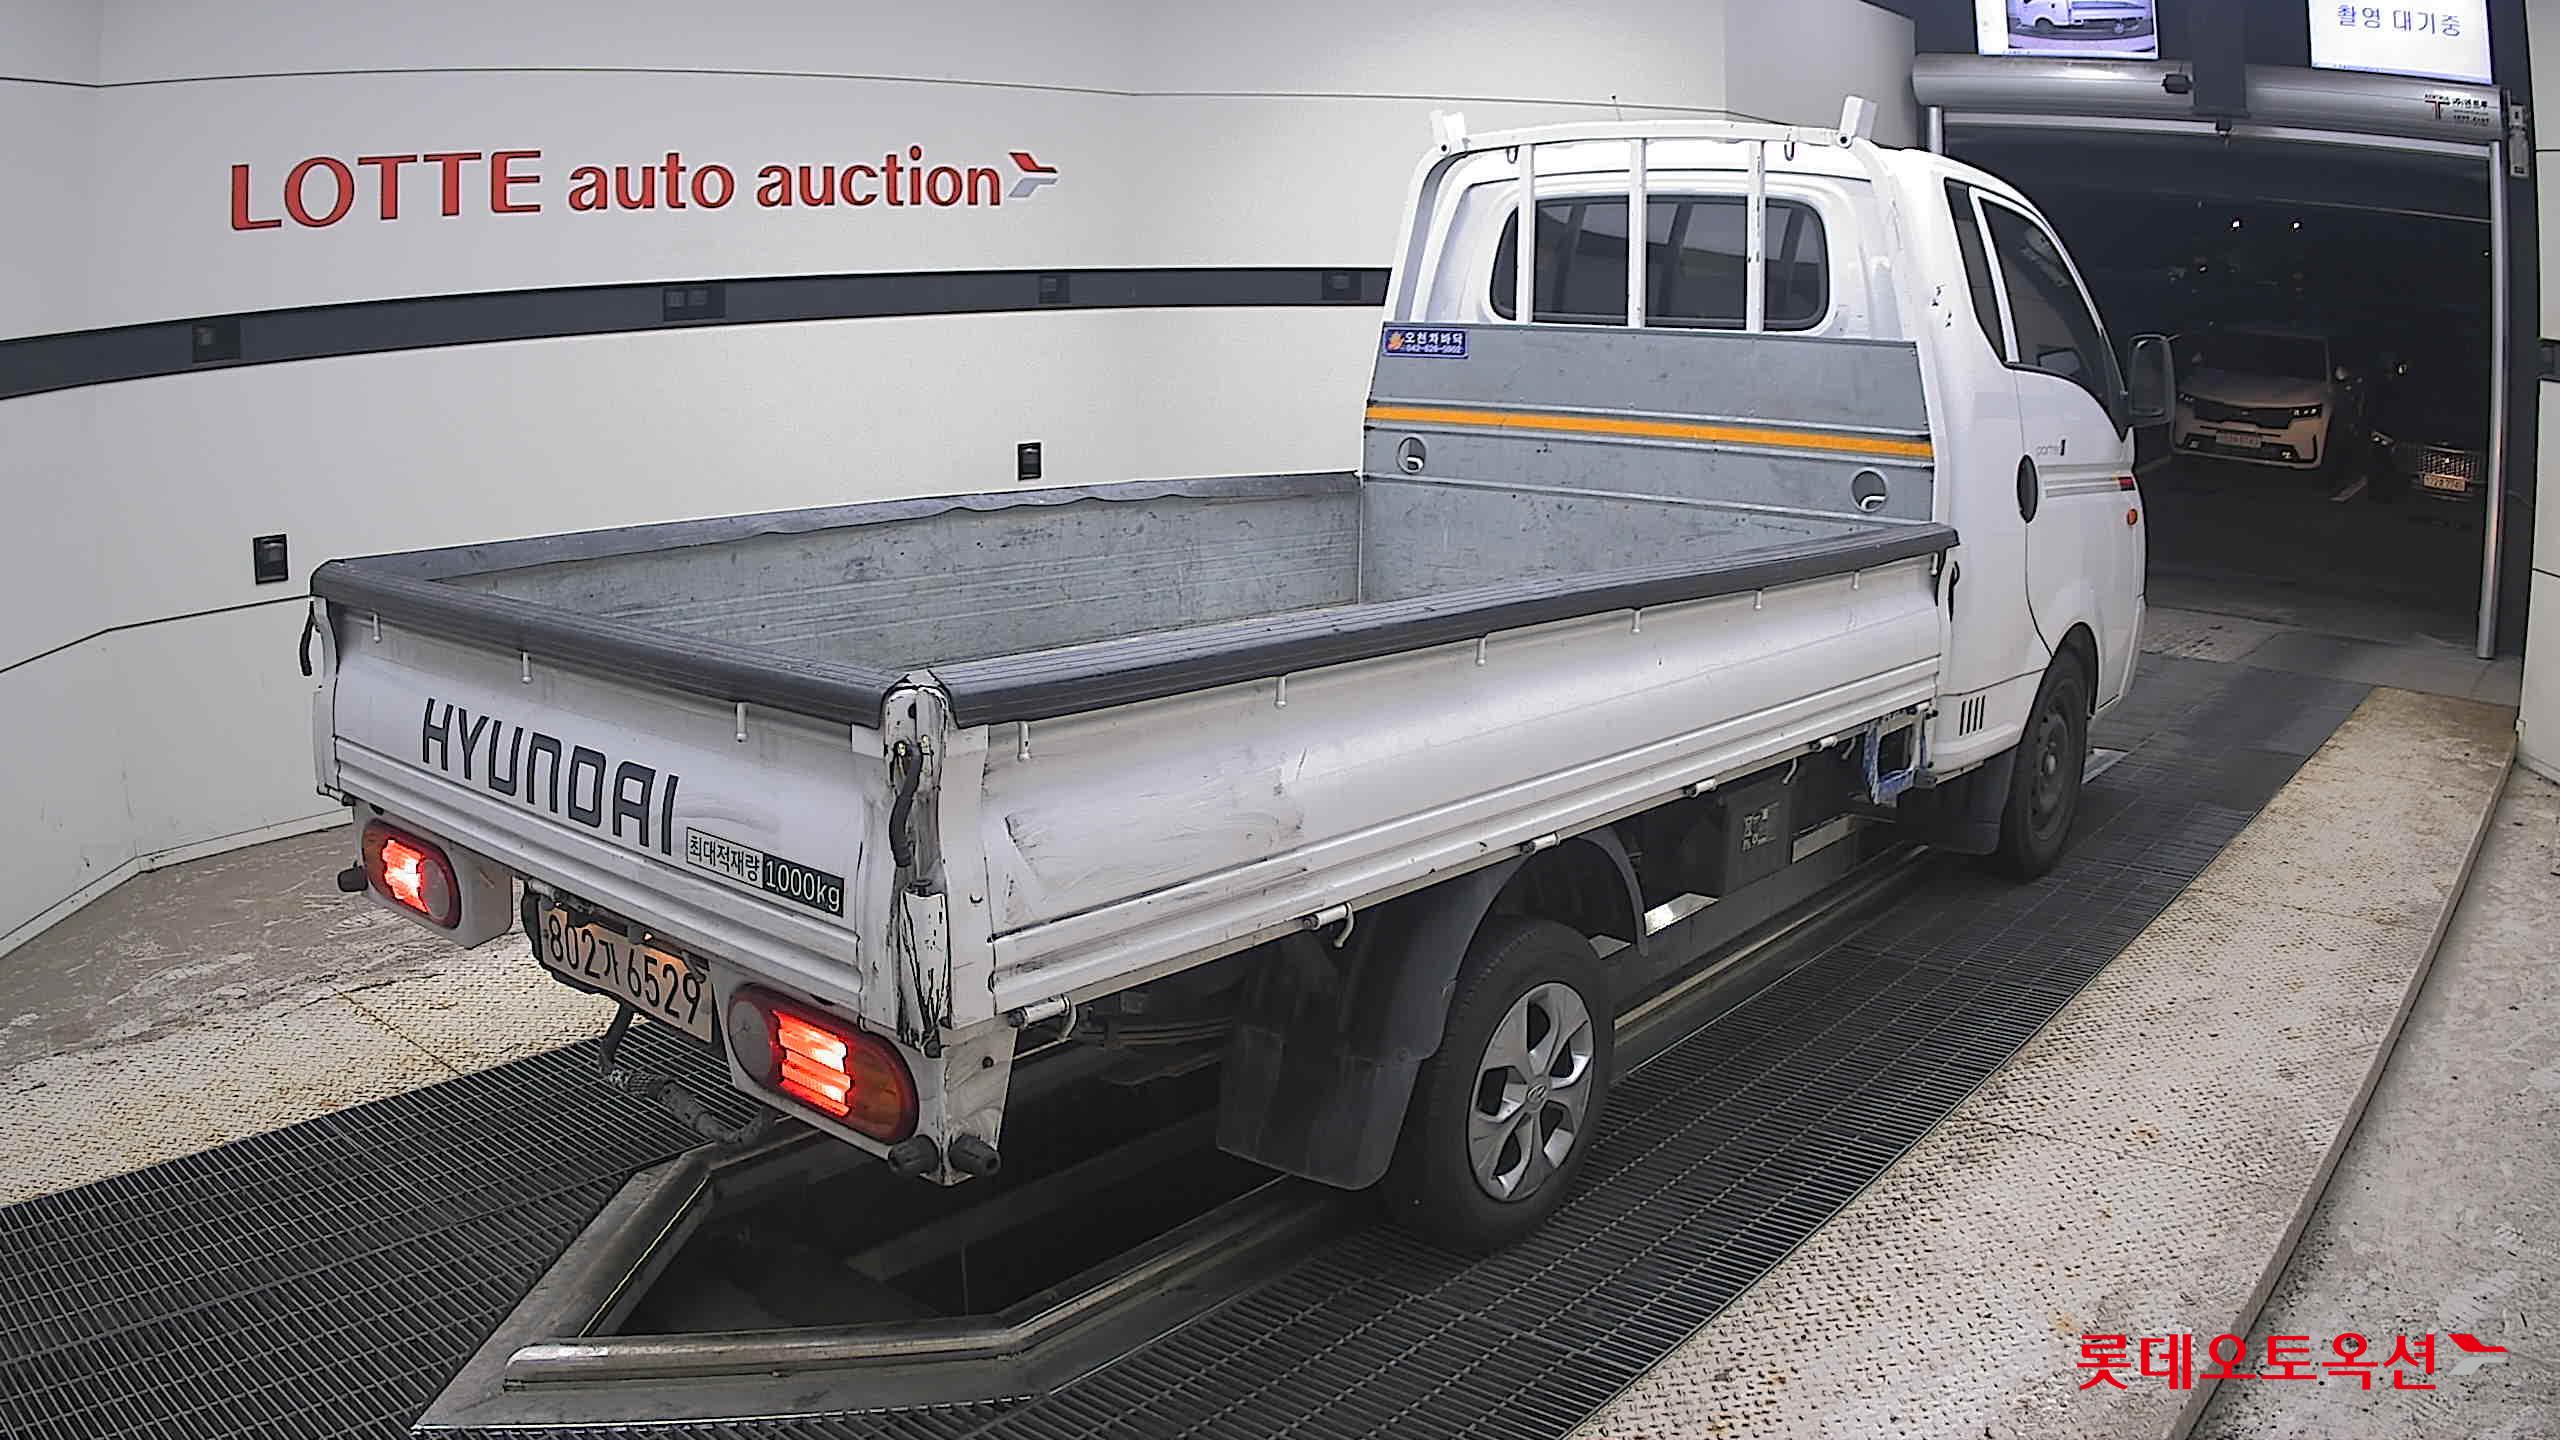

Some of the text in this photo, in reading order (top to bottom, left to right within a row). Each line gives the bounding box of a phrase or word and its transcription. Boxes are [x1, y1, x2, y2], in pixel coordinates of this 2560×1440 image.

[2338, 5, 2461, 37] 촬영 대기중
[231, 145, 1001, 231] LOTTE auto auction
[421, 697, 680, 857] HYUNDAI
[688, 834, 841, 914] 최대적재량 1000kg
